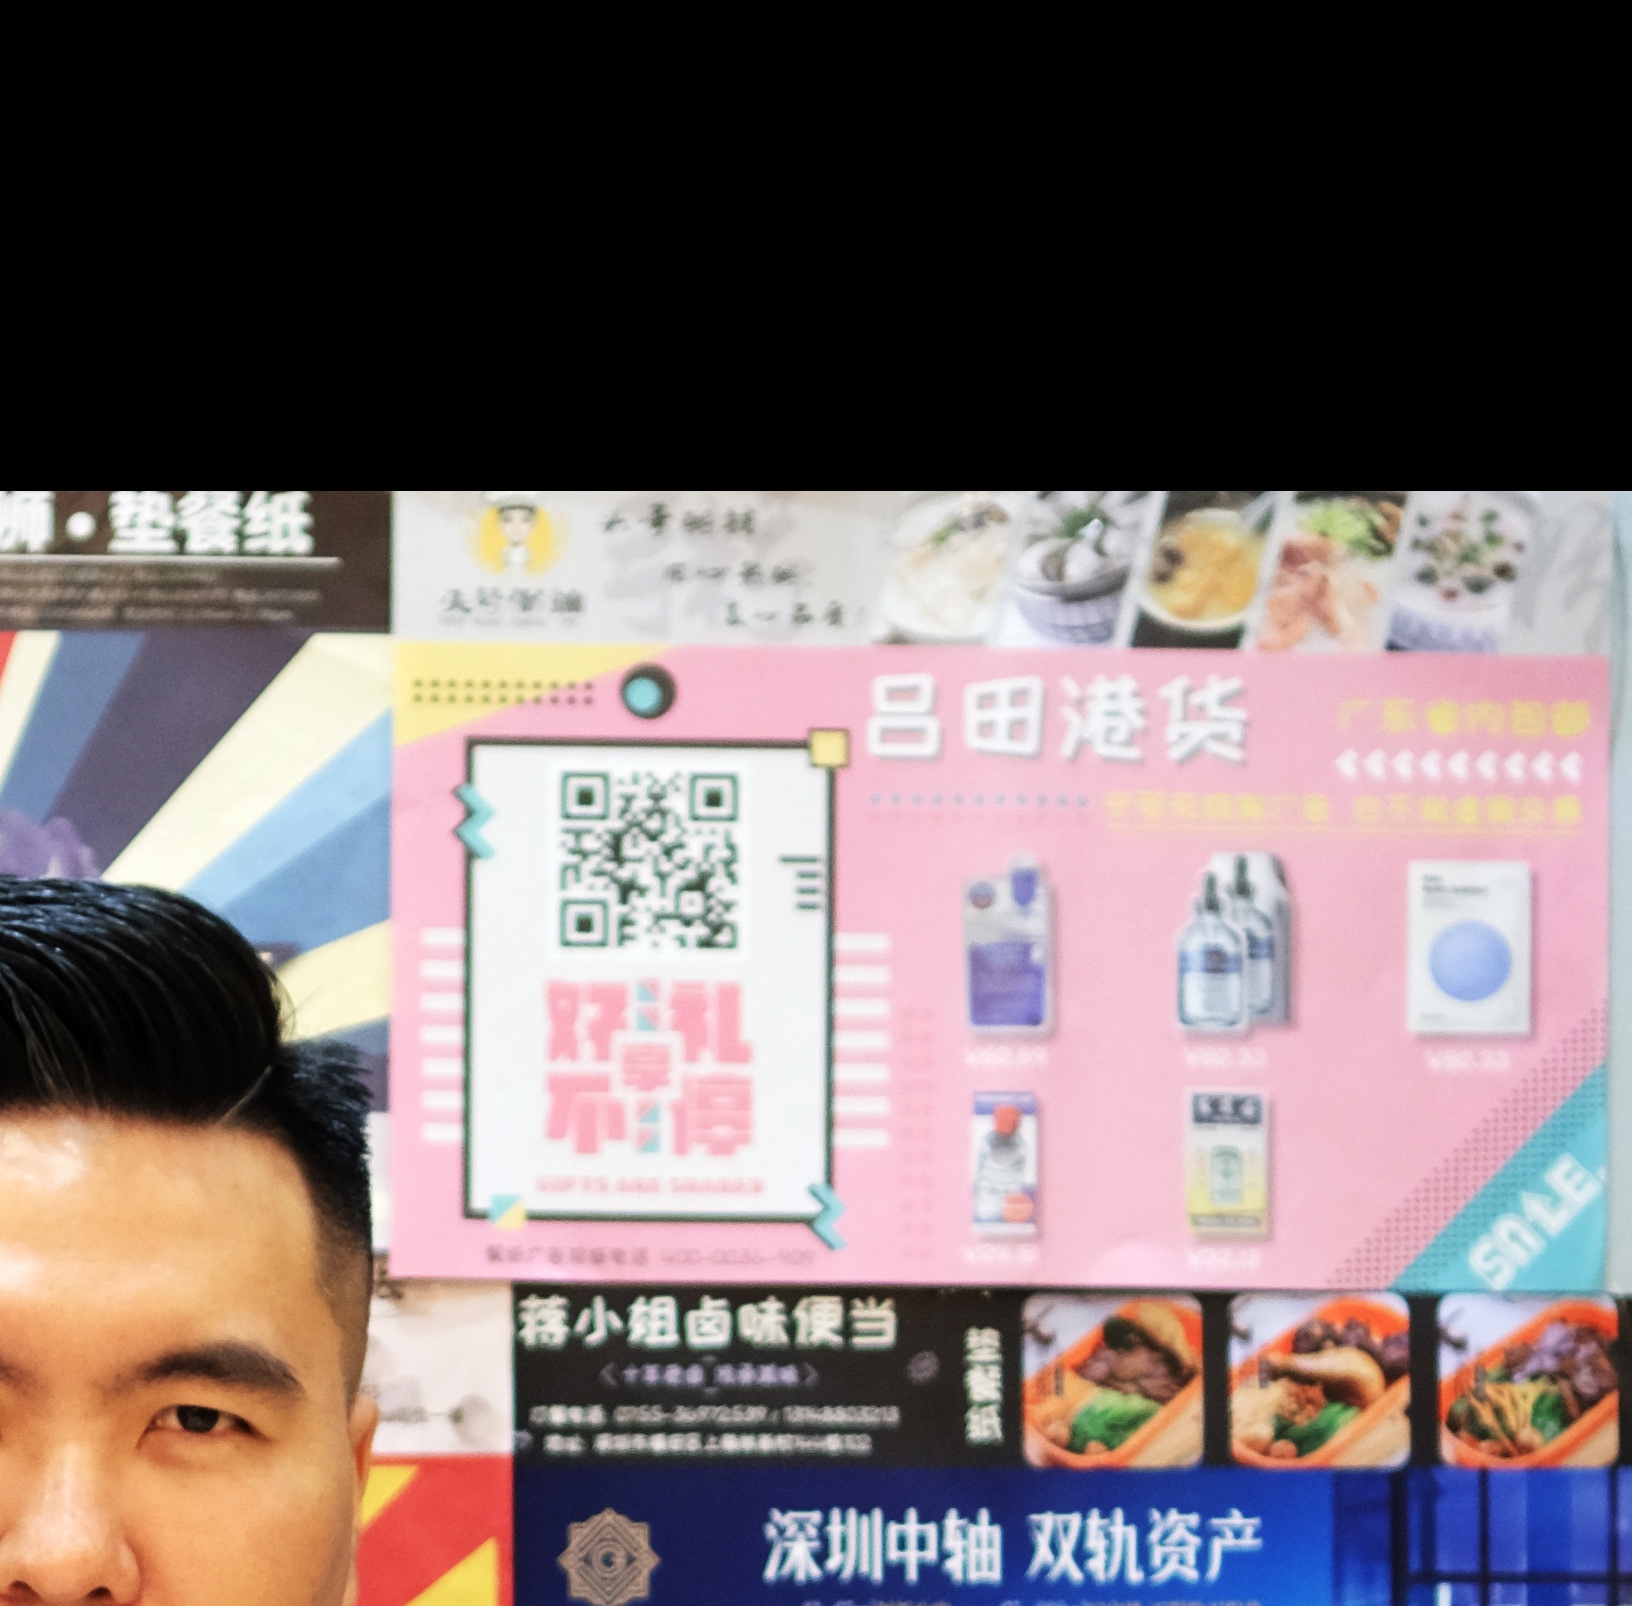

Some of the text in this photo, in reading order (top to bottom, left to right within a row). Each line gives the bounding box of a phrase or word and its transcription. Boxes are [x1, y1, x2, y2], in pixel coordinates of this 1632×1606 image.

[868, 672, 1251, 761] 吕田港货
[518, 1295, 897, 1348] 蒋小姐卤味便当
[762, 1506, 1263, 1586] 深圳中轴 双轨资产
